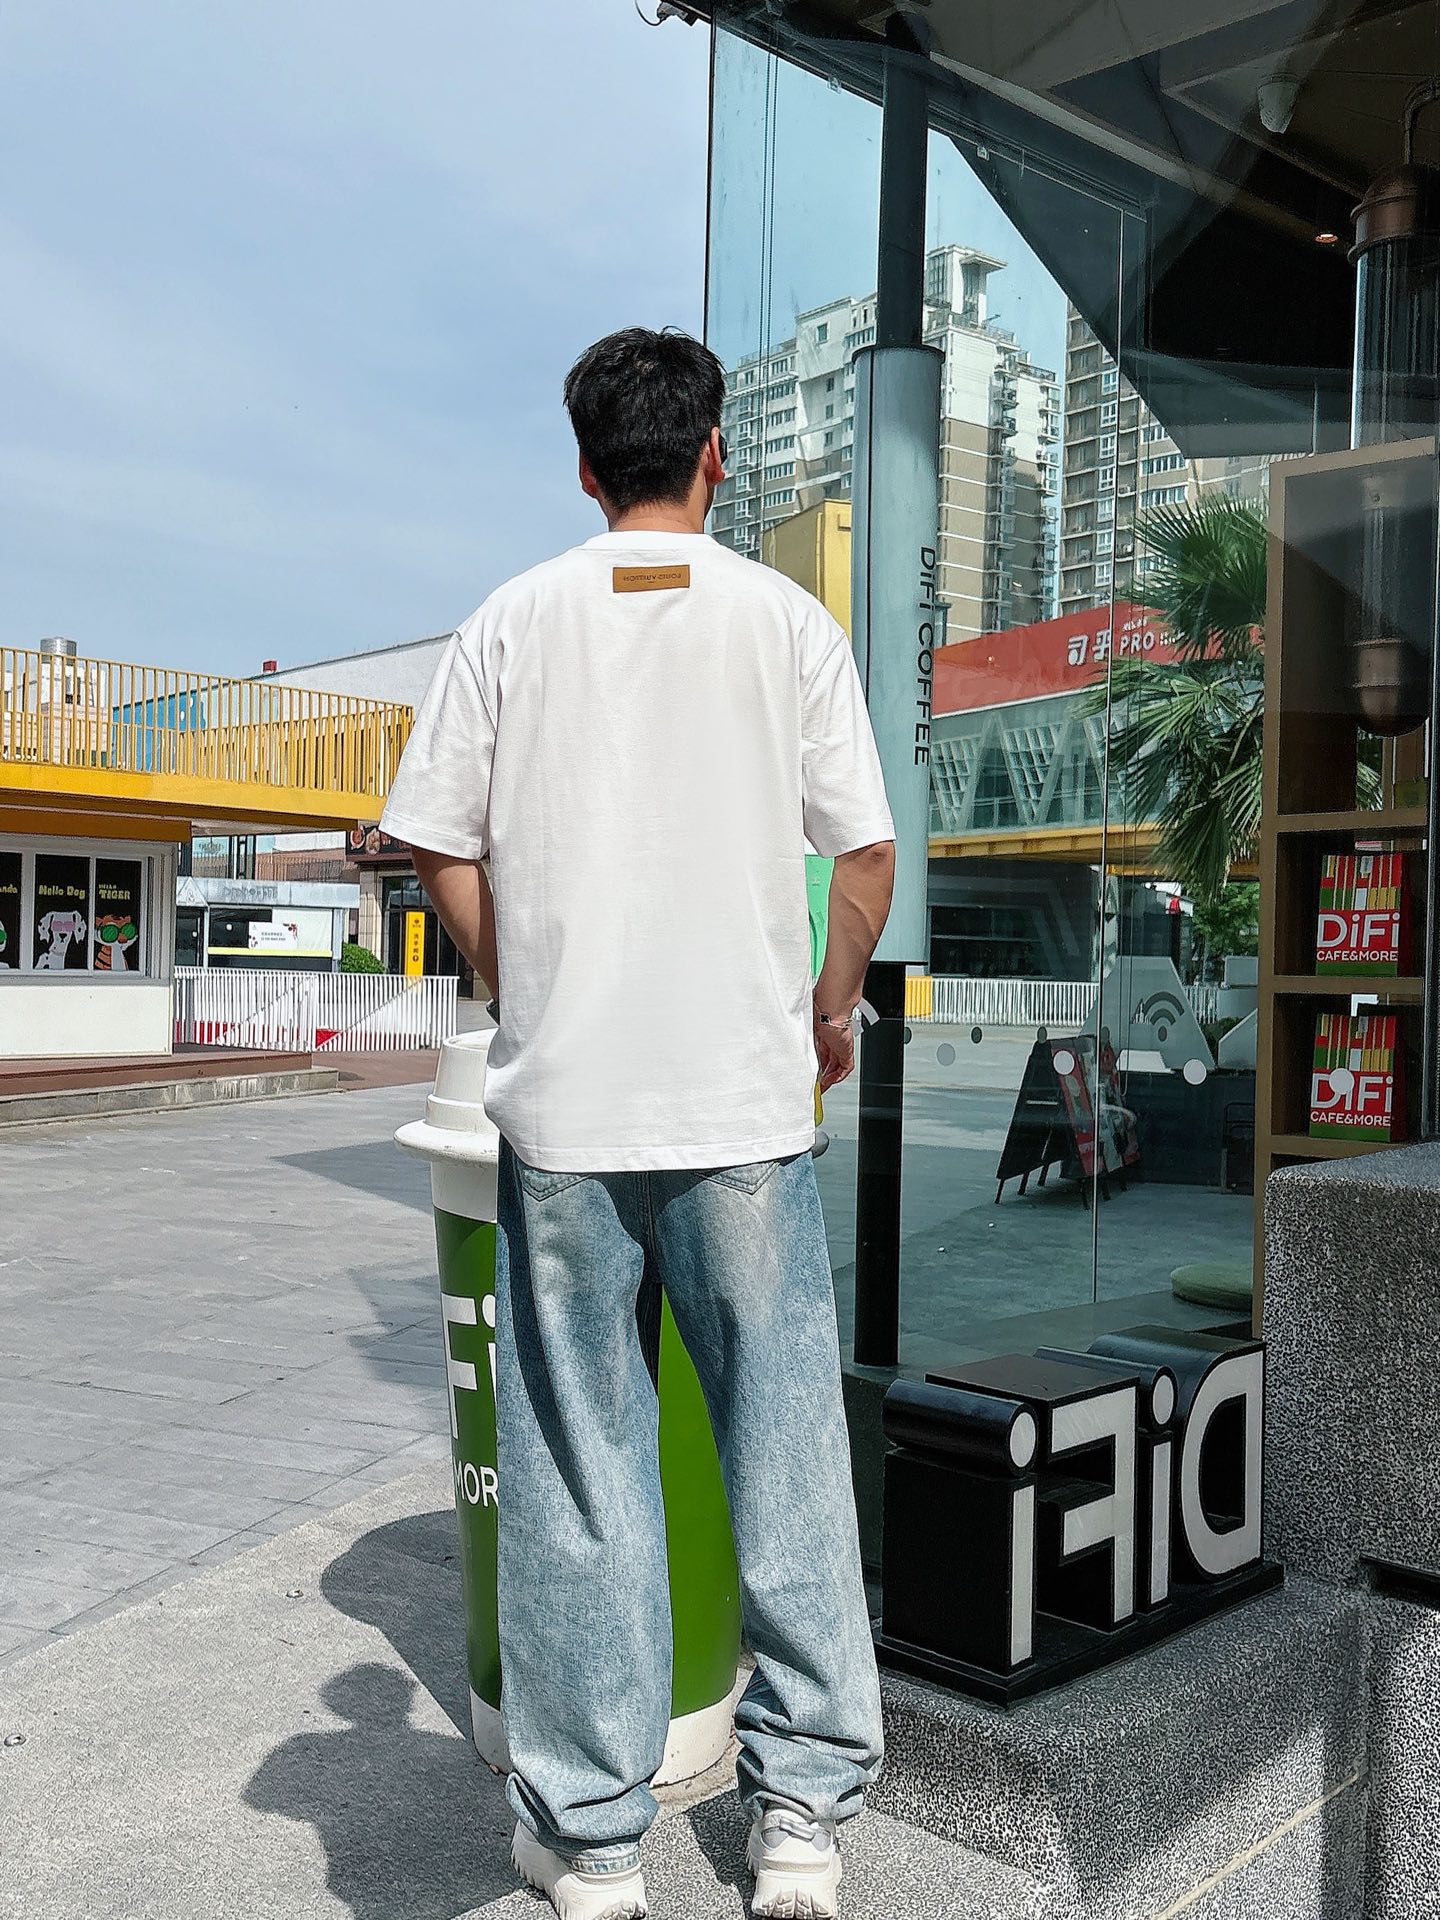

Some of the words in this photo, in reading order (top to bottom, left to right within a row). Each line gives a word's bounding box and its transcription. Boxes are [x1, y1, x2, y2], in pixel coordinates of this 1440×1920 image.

[919, 546, 936, 611] DiFi
[1119, 631, 1156, 656] PRO
[914, 622, 933, 766] COFFEE
[98, 889, 131, 900] TIGER
[1317, 912, 1401, 948] DiFi
[1316, 950, 1398, 961] CAFE&MORE
[1310, 1111, 1391, 1127] CAFE&MORE
